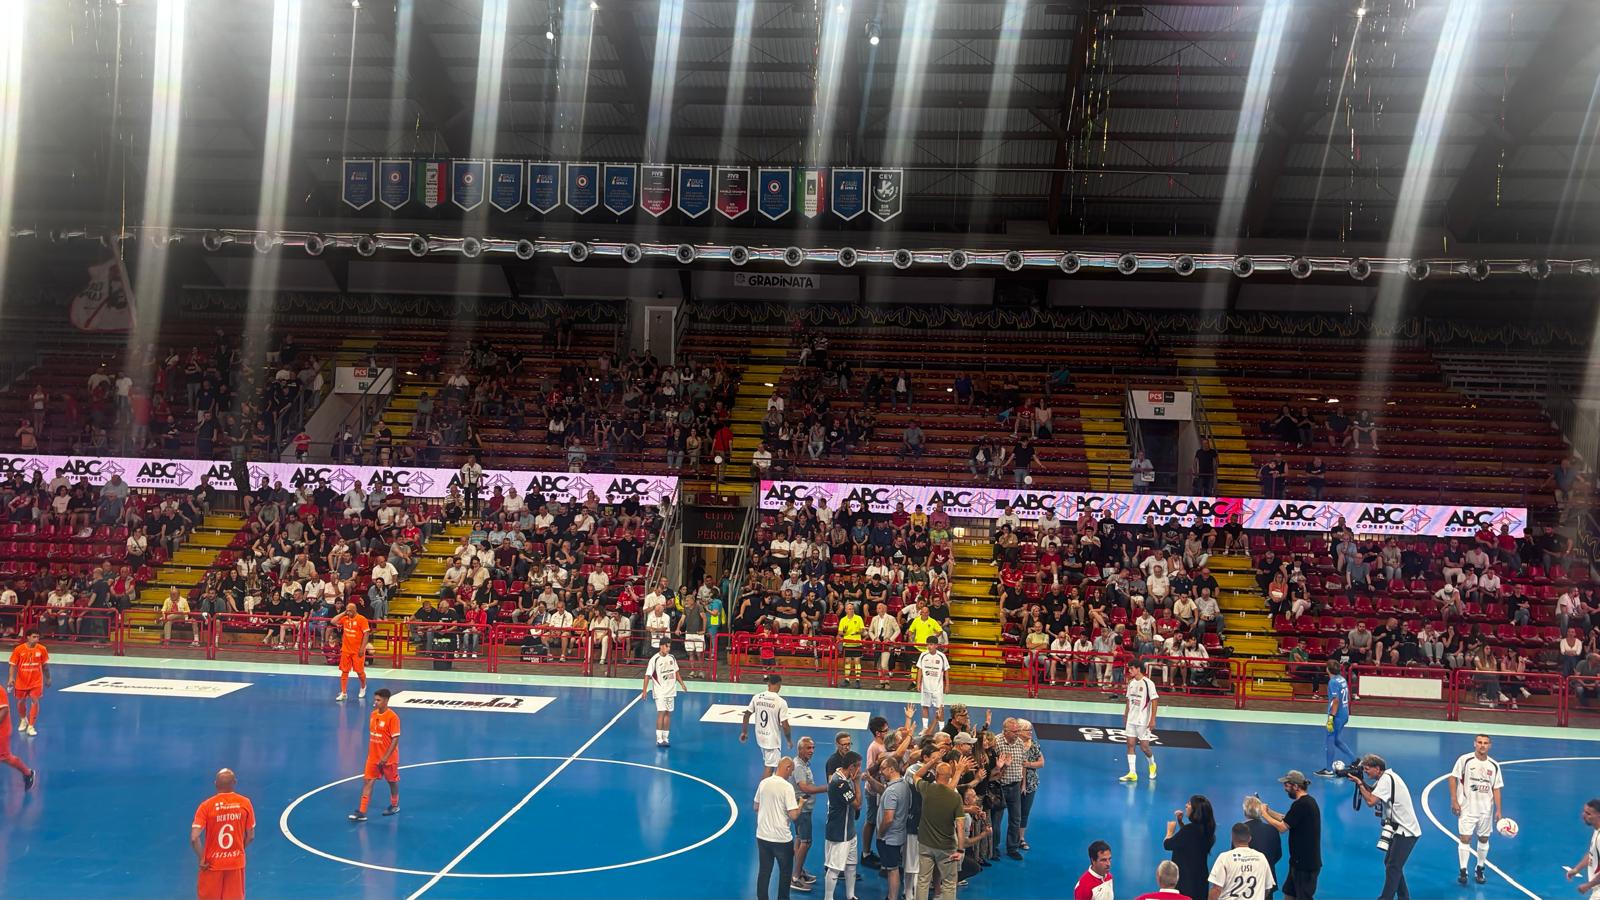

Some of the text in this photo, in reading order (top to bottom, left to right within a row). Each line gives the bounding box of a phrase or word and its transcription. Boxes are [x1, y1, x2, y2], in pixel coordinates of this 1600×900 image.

[62, 460, 102, 475] ABC
[137, 462, 176, 478] ABC
[207, 464, 233, 480] AB
[290, 467, 332, 484] ABC
[367, 470, 411, 487] ABC
[526, 475, 569, 492] ABC
[606, 478, 649, 495] ABC
[765, 485, 808, 501] ABC
[847, 487, 890, 504] ABC
[927, 491, 972, 508] ABC
[1012, 494, 1056, 511] ABC
[1143, 499, 1230, 517] ABCABC
[1269, 504, 1317, 521] ABC
[1356, 507, 1405, 524] ABC
[1445, 510, 1494, 527] ABC
[1355, 523, 1405, 531] COPERTURE
[760, 710, 768, 728] 9
[218, 824, 234, 849] 6
[1230, 876, 1257, 899] 23
